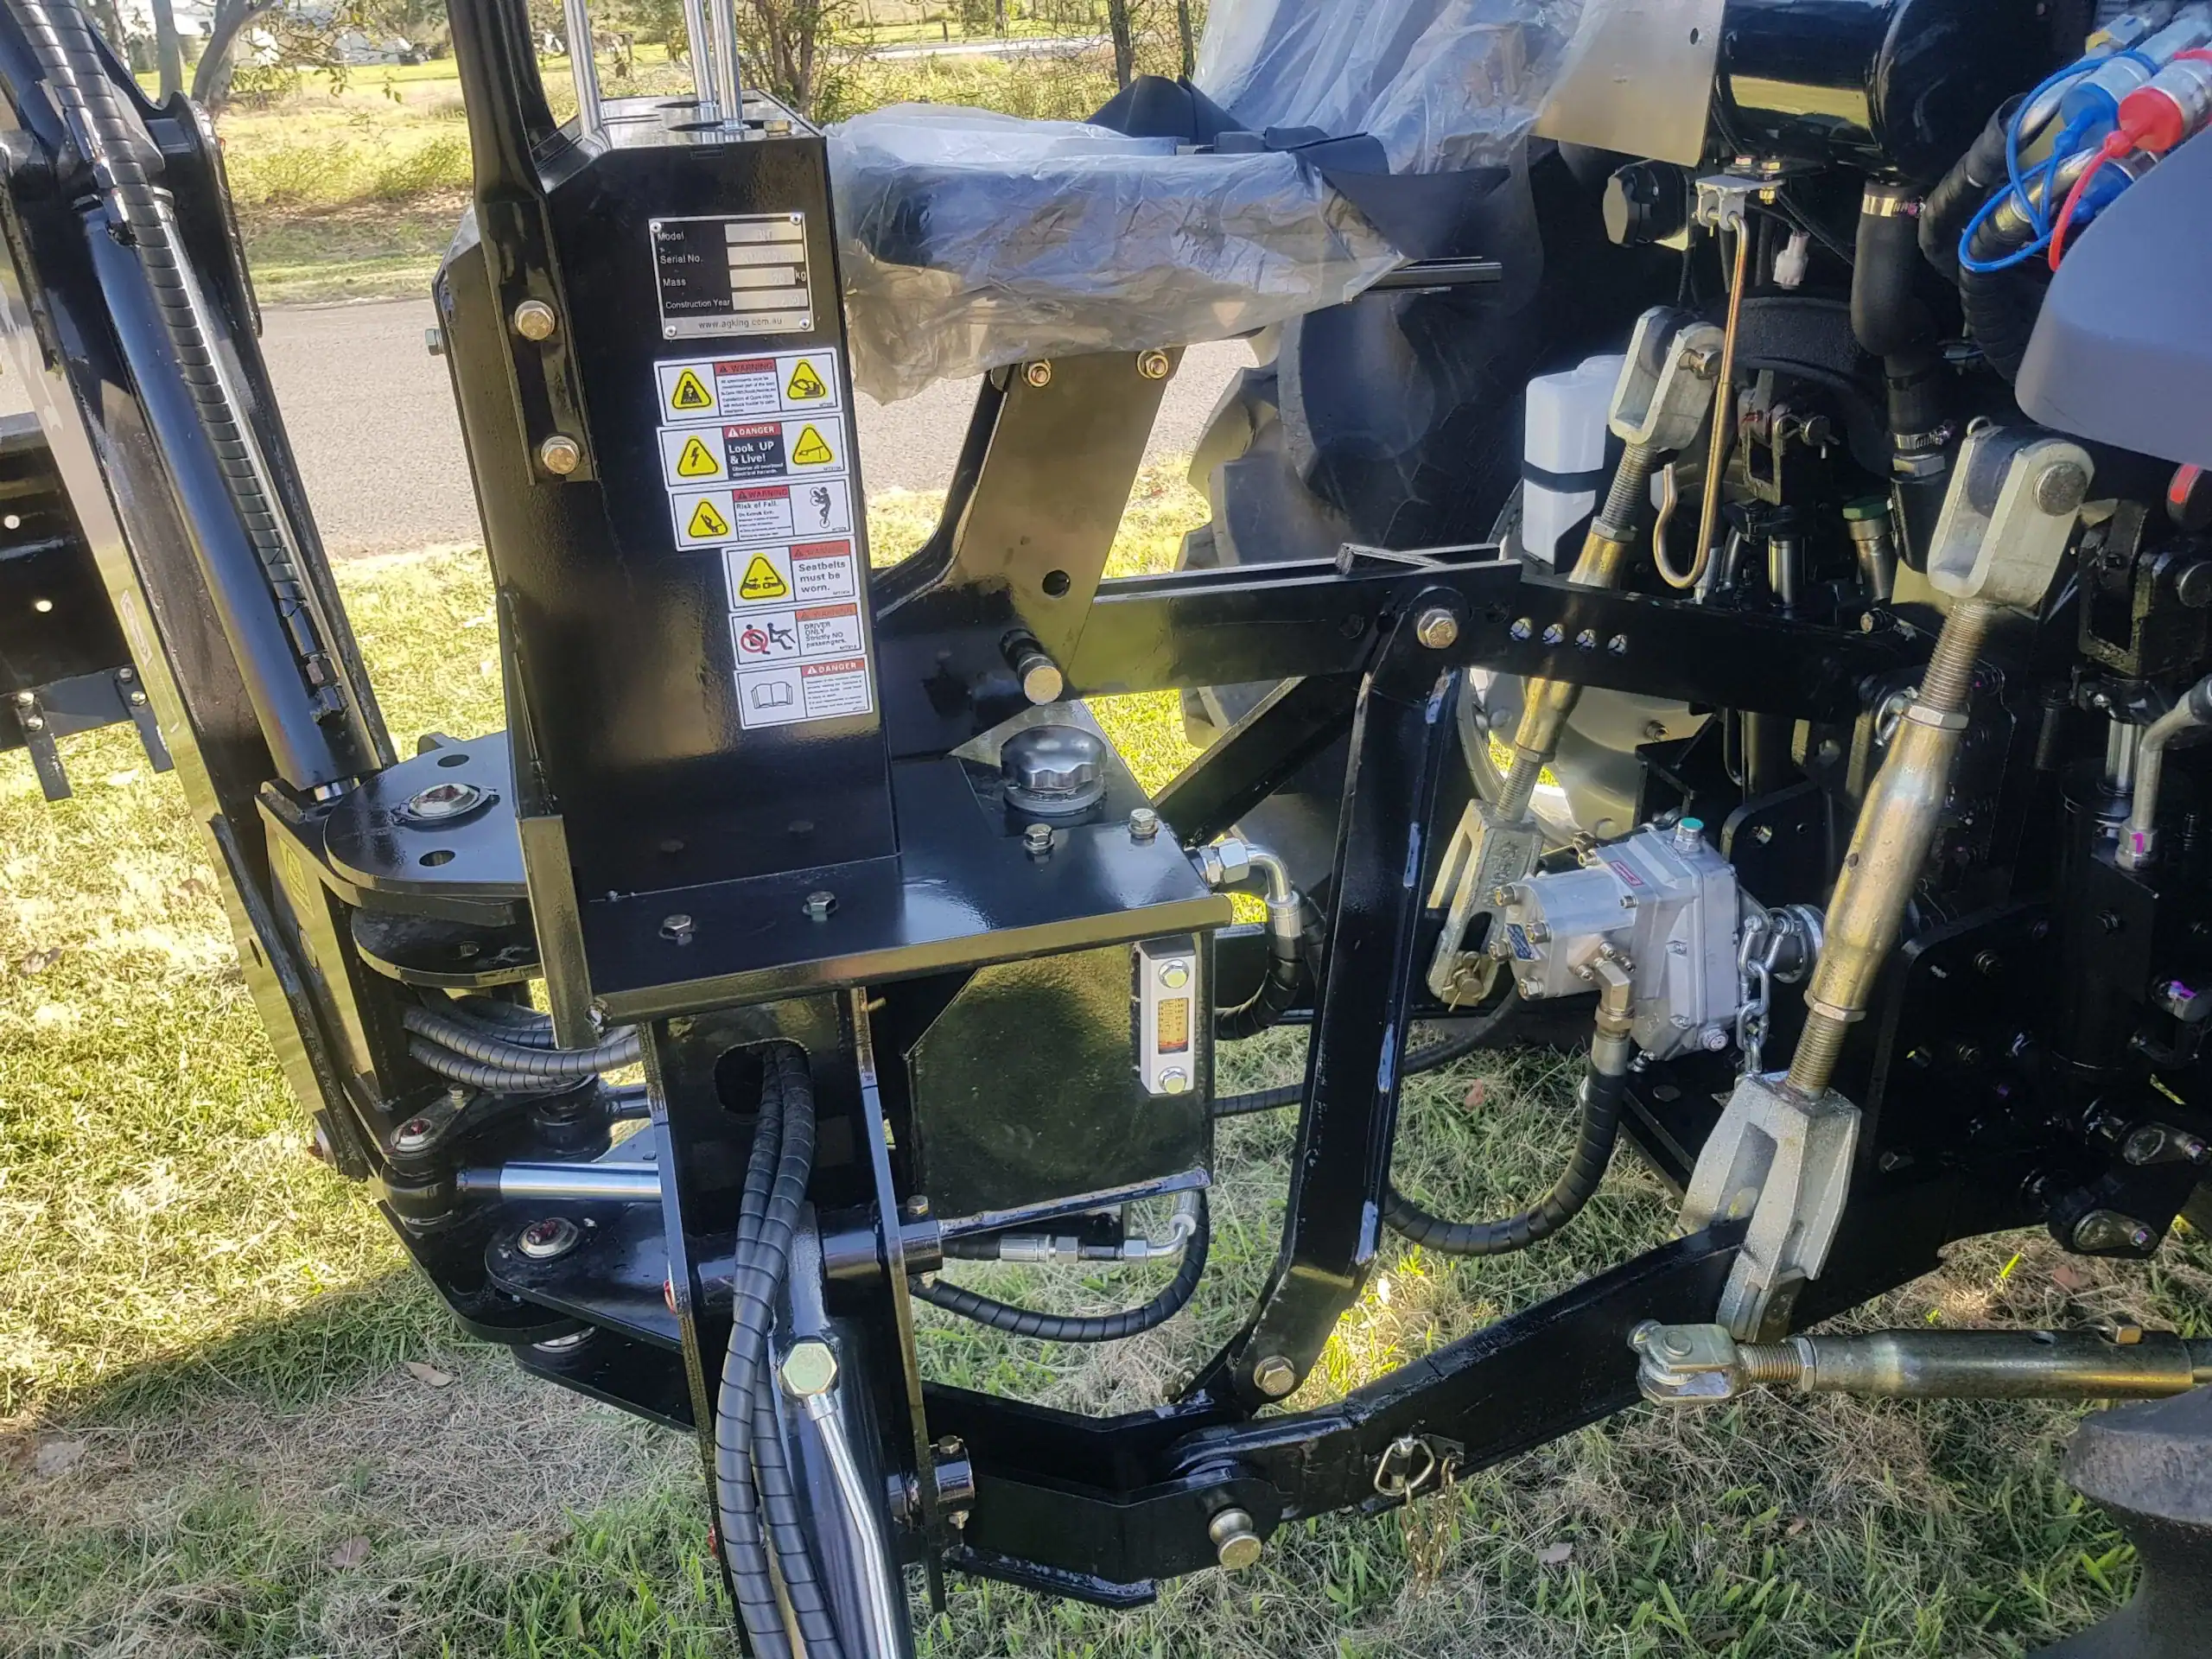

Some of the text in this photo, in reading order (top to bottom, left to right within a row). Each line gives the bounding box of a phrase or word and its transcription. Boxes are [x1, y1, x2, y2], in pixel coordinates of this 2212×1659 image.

[658, 232, 684, 242] Model
[660, 253, 703, 264] Serial No.
[795, 270, 806, 282] kg
[663, 278, 687, 287] Mass
[665, 301, 712, 310] Construction
[731, 362, 773, 373] WARNING
[739, 426, 775, 436] DANGER
[728, 441, 775, 454] Look UP
[730, 453, 766, 465] & Live!
[748, 488, 788, 499] WARNING
[798, 561, 846, 572] Seatbelts
[800, 574, 826, 583] must
[801, 584, 830, 594] worn.
[804, 621, 831, 630] DRIVER
[805, 633, 830, 642] Strictly
[806, 639, 847, 648] passengers.
[818, 662, 857, 673] DANGER
